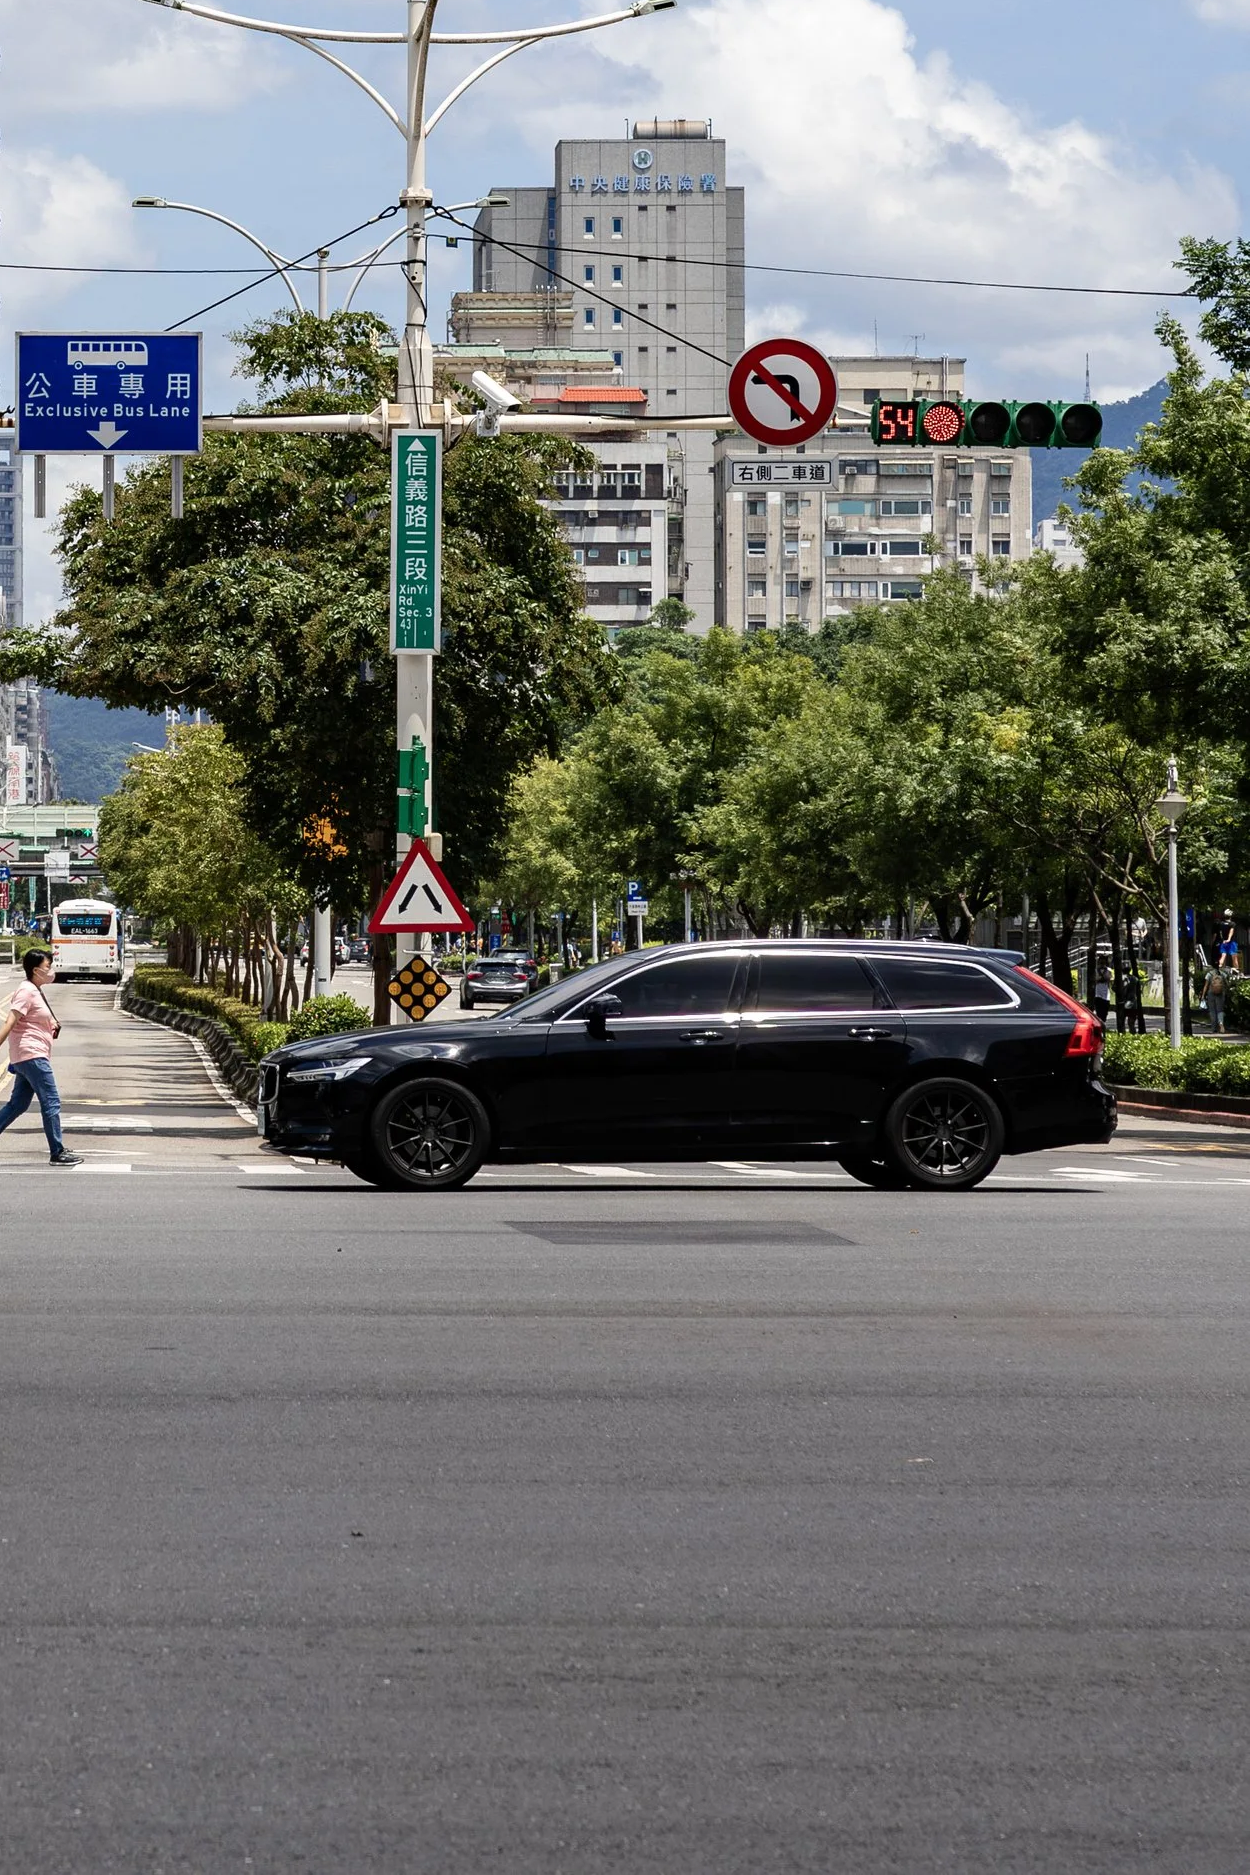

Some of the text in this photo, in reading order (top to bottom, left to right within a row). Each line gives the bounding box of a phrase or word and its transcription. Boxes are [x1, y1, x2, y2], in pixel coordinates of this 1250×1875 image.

[569, 174, 717, 191] 中央健康保險署
[25, 372, 192, 400] 公車專用
[24, 402, 191, 418] Exclusive Bus Lane
[879, 406, 914, 440] 54
[738, 464, 826, 482] 右側二車道
[404, 452, 428, 581] 信義路三段
[399, 584, 428, 595] XinYi
[398, 595, 416, 606] Rd.
[398, 606, 433, 618] Sec. 3
[400, 618, 412, 630] 43
[628, 881, 639, 895] P
